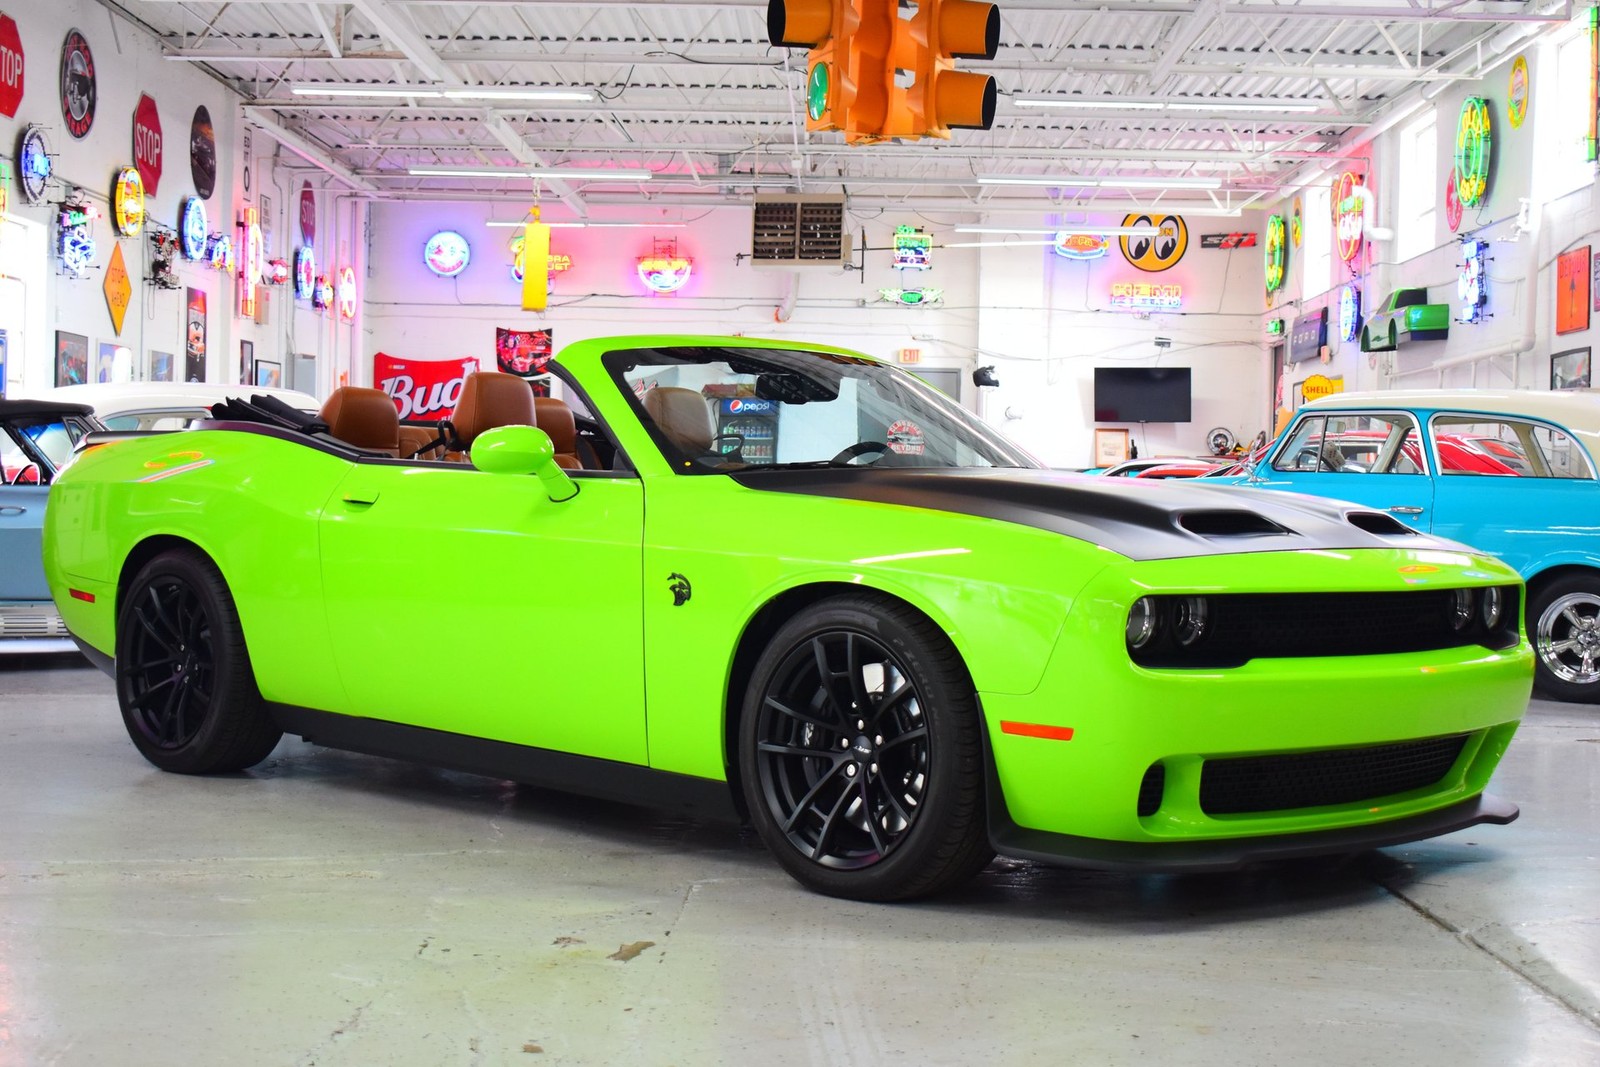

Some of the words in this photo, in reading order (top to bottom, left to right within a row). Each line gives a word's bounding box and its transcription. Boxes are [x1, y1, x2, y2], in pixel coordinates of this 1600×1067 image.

[0, 46, 23, 89] TOP
[136, 122, 161, 168] STOP
[1158, 227, 1174, 236] ON
[547, 255, 570, 263] BRA
[1292, 330, 1316, 346] FORD
[903, 349, 920, 362] EXIT
[381, 361, 476, 421] Bud
[1305, 386, 1329, 394] SHELL
[743, 402, 770, 412] pepsi
